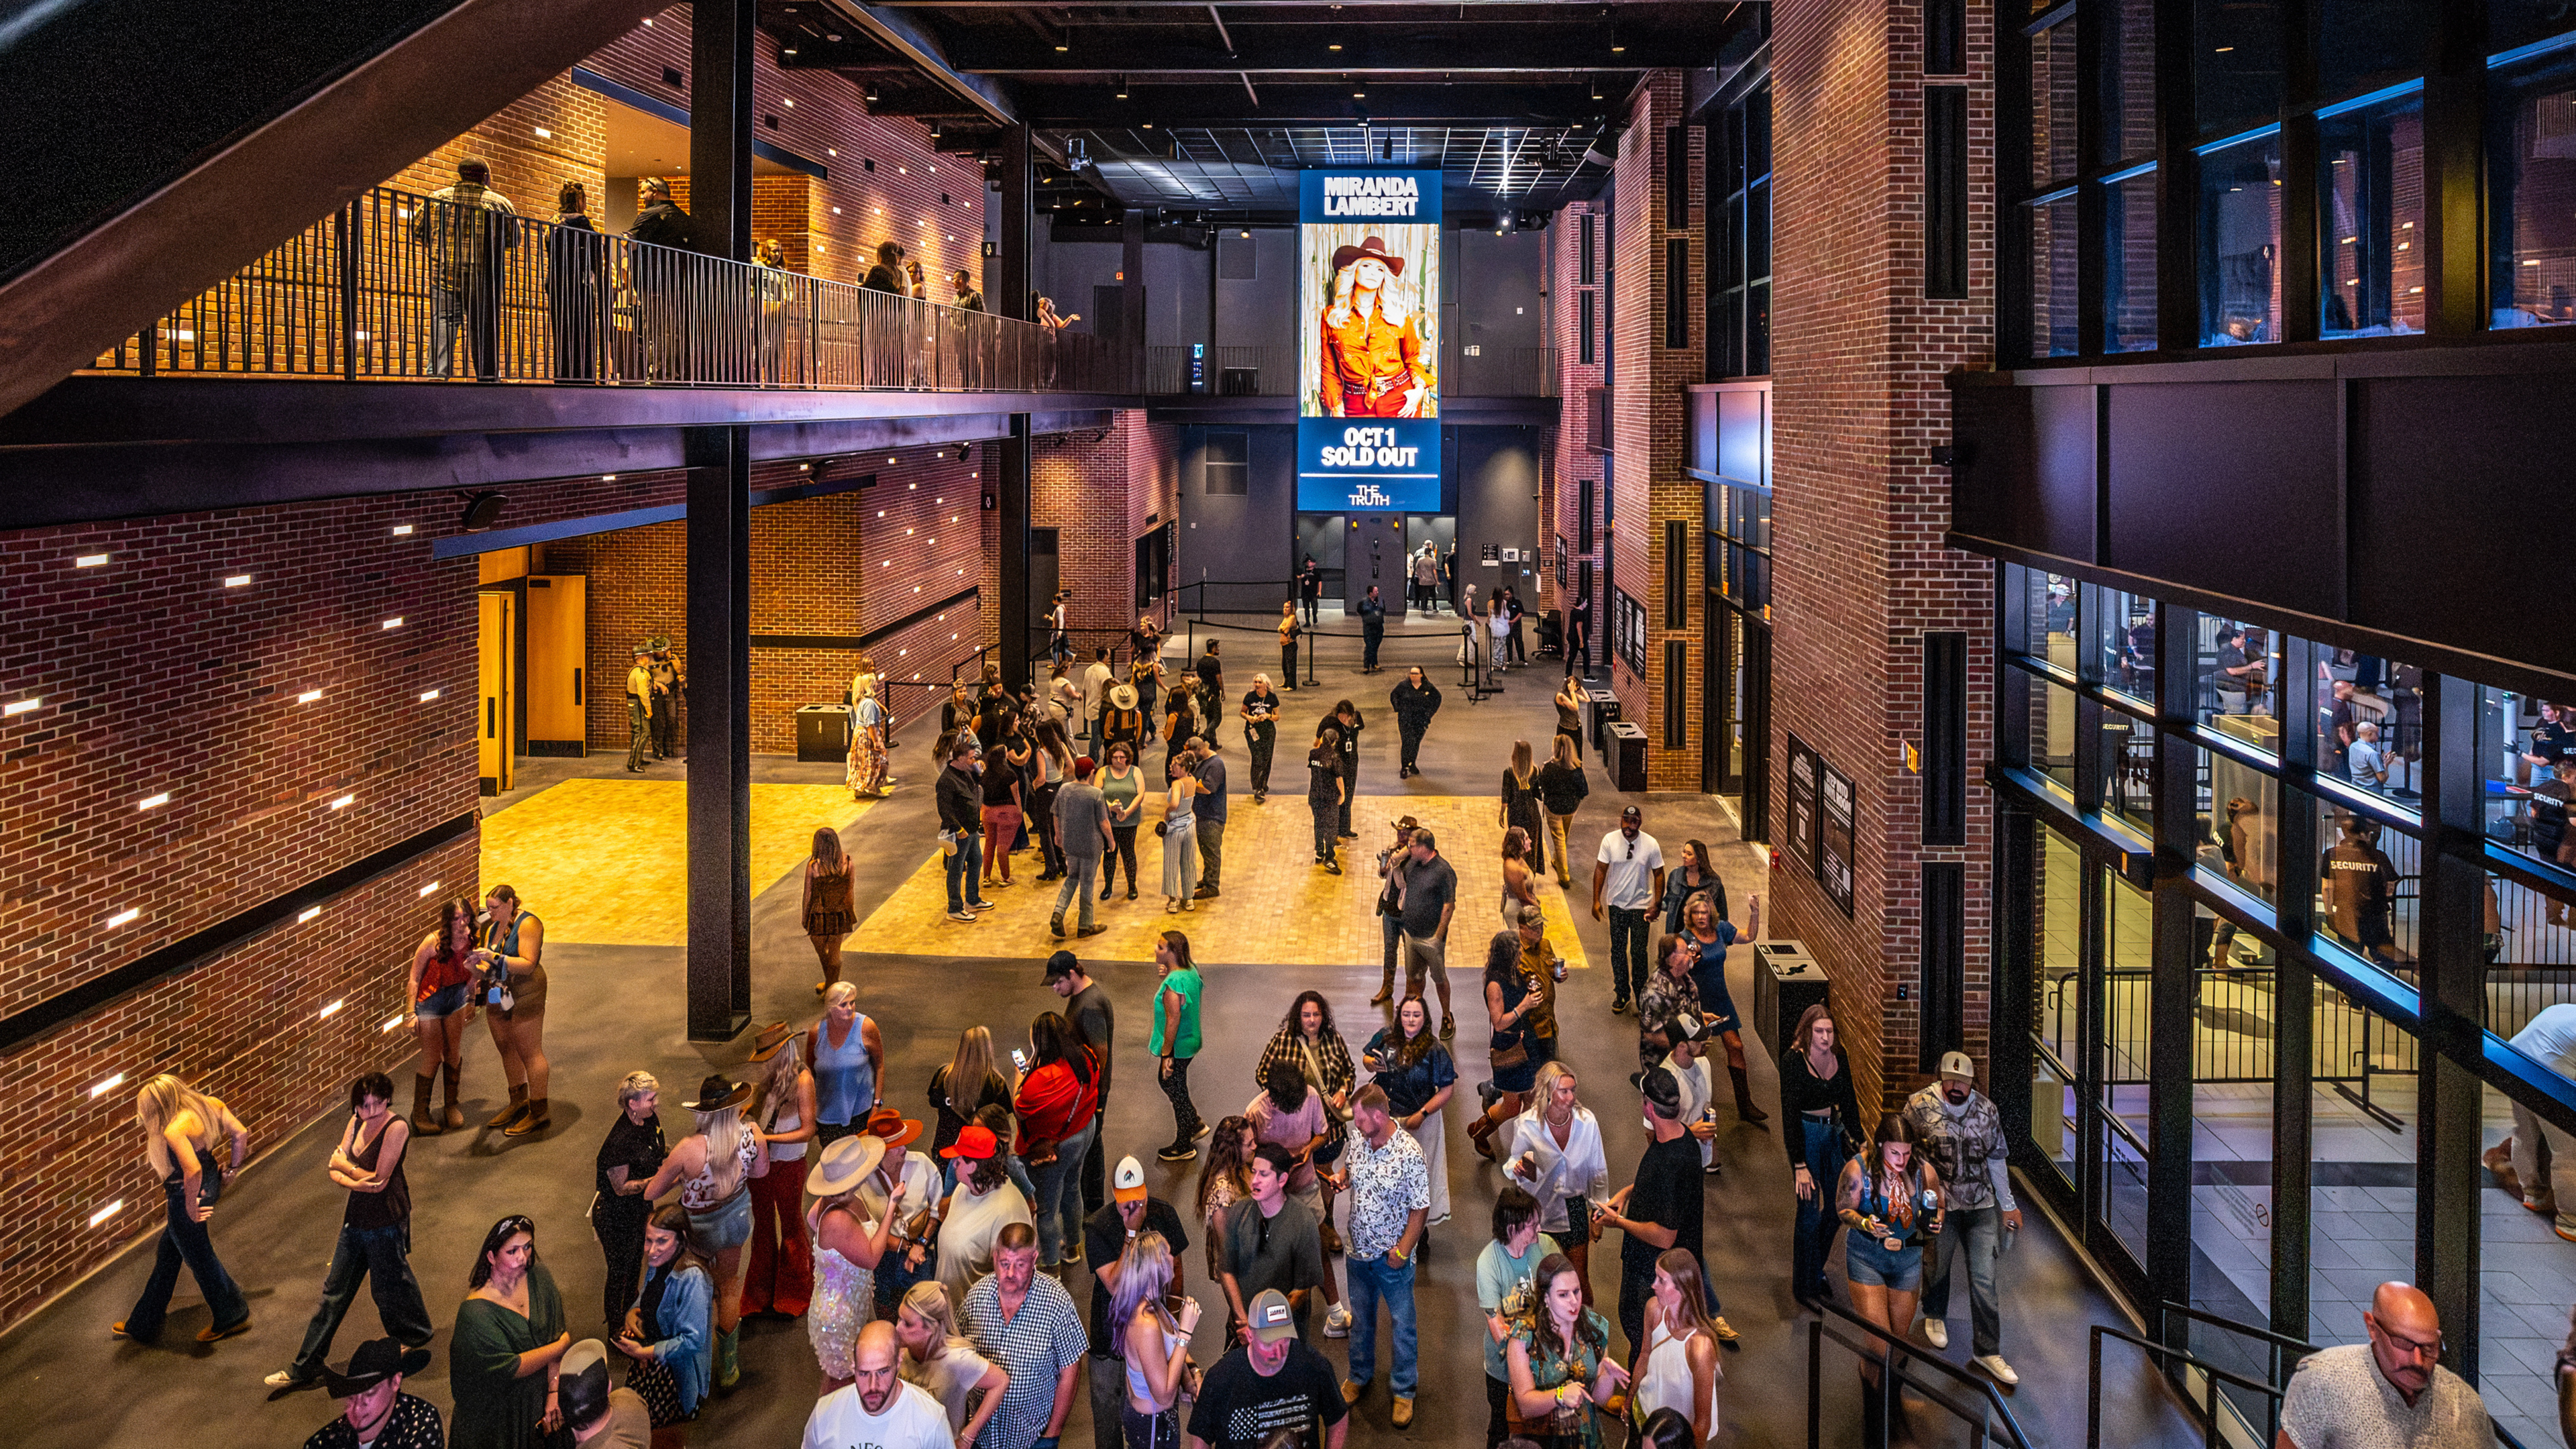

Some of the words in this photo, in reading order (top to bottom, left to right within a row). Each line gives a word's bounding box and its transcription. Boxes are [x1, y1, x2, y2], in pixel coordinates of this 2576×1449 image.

[1324, 176, 1419, 197] MIRANDA
[1324, 197, 1419, 216] LAMBERT
[1344, 427, 1385, 447] OCT
[1385, 427, 1395, 447] 1
[1321, 446, 1375, 466] SOLD
[1377, 447, 1418, 467] OUT
[1348, 494, 1390, 506] TRUTH
[1356, 485, 1380, 496] THE
[1826, 769, 1837, 789] STEP
[1837, 779, 1848, 800] INTO
[1836, 791, 1851, 816] ROOM
[2330, 861, 2377, 872] SECURITY
